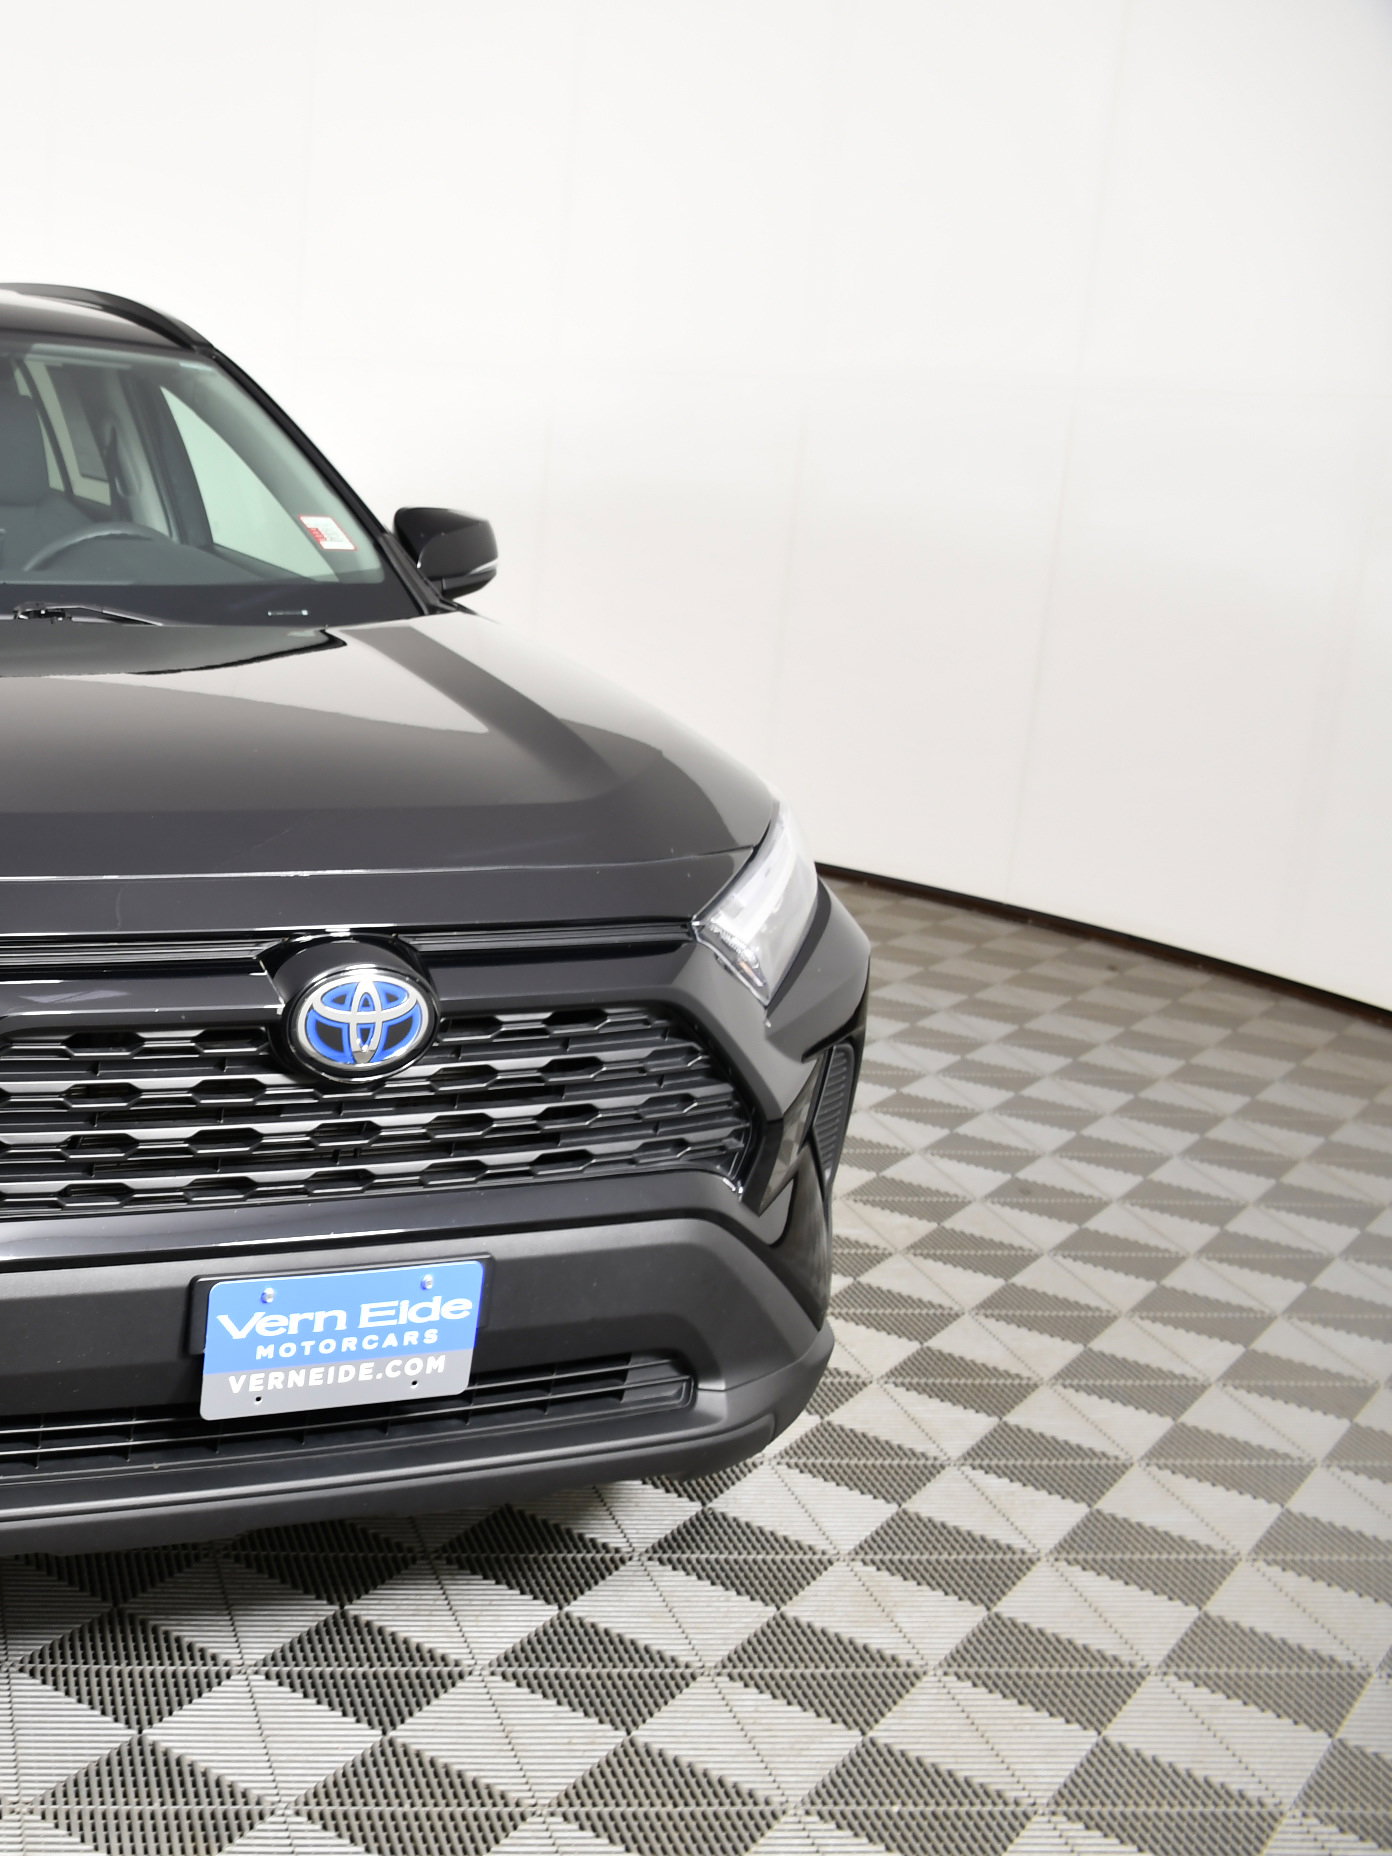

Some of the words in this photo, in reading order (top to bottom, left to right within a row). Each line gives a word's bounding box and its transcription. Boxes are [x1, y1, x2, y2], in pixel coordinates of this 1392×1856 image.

[216, 1309, 347, 1340] Vern
[255, 1328, 440, 1360] MOTORCARS
[228, 1355, 446, 1394] VERNEIDE.COM
